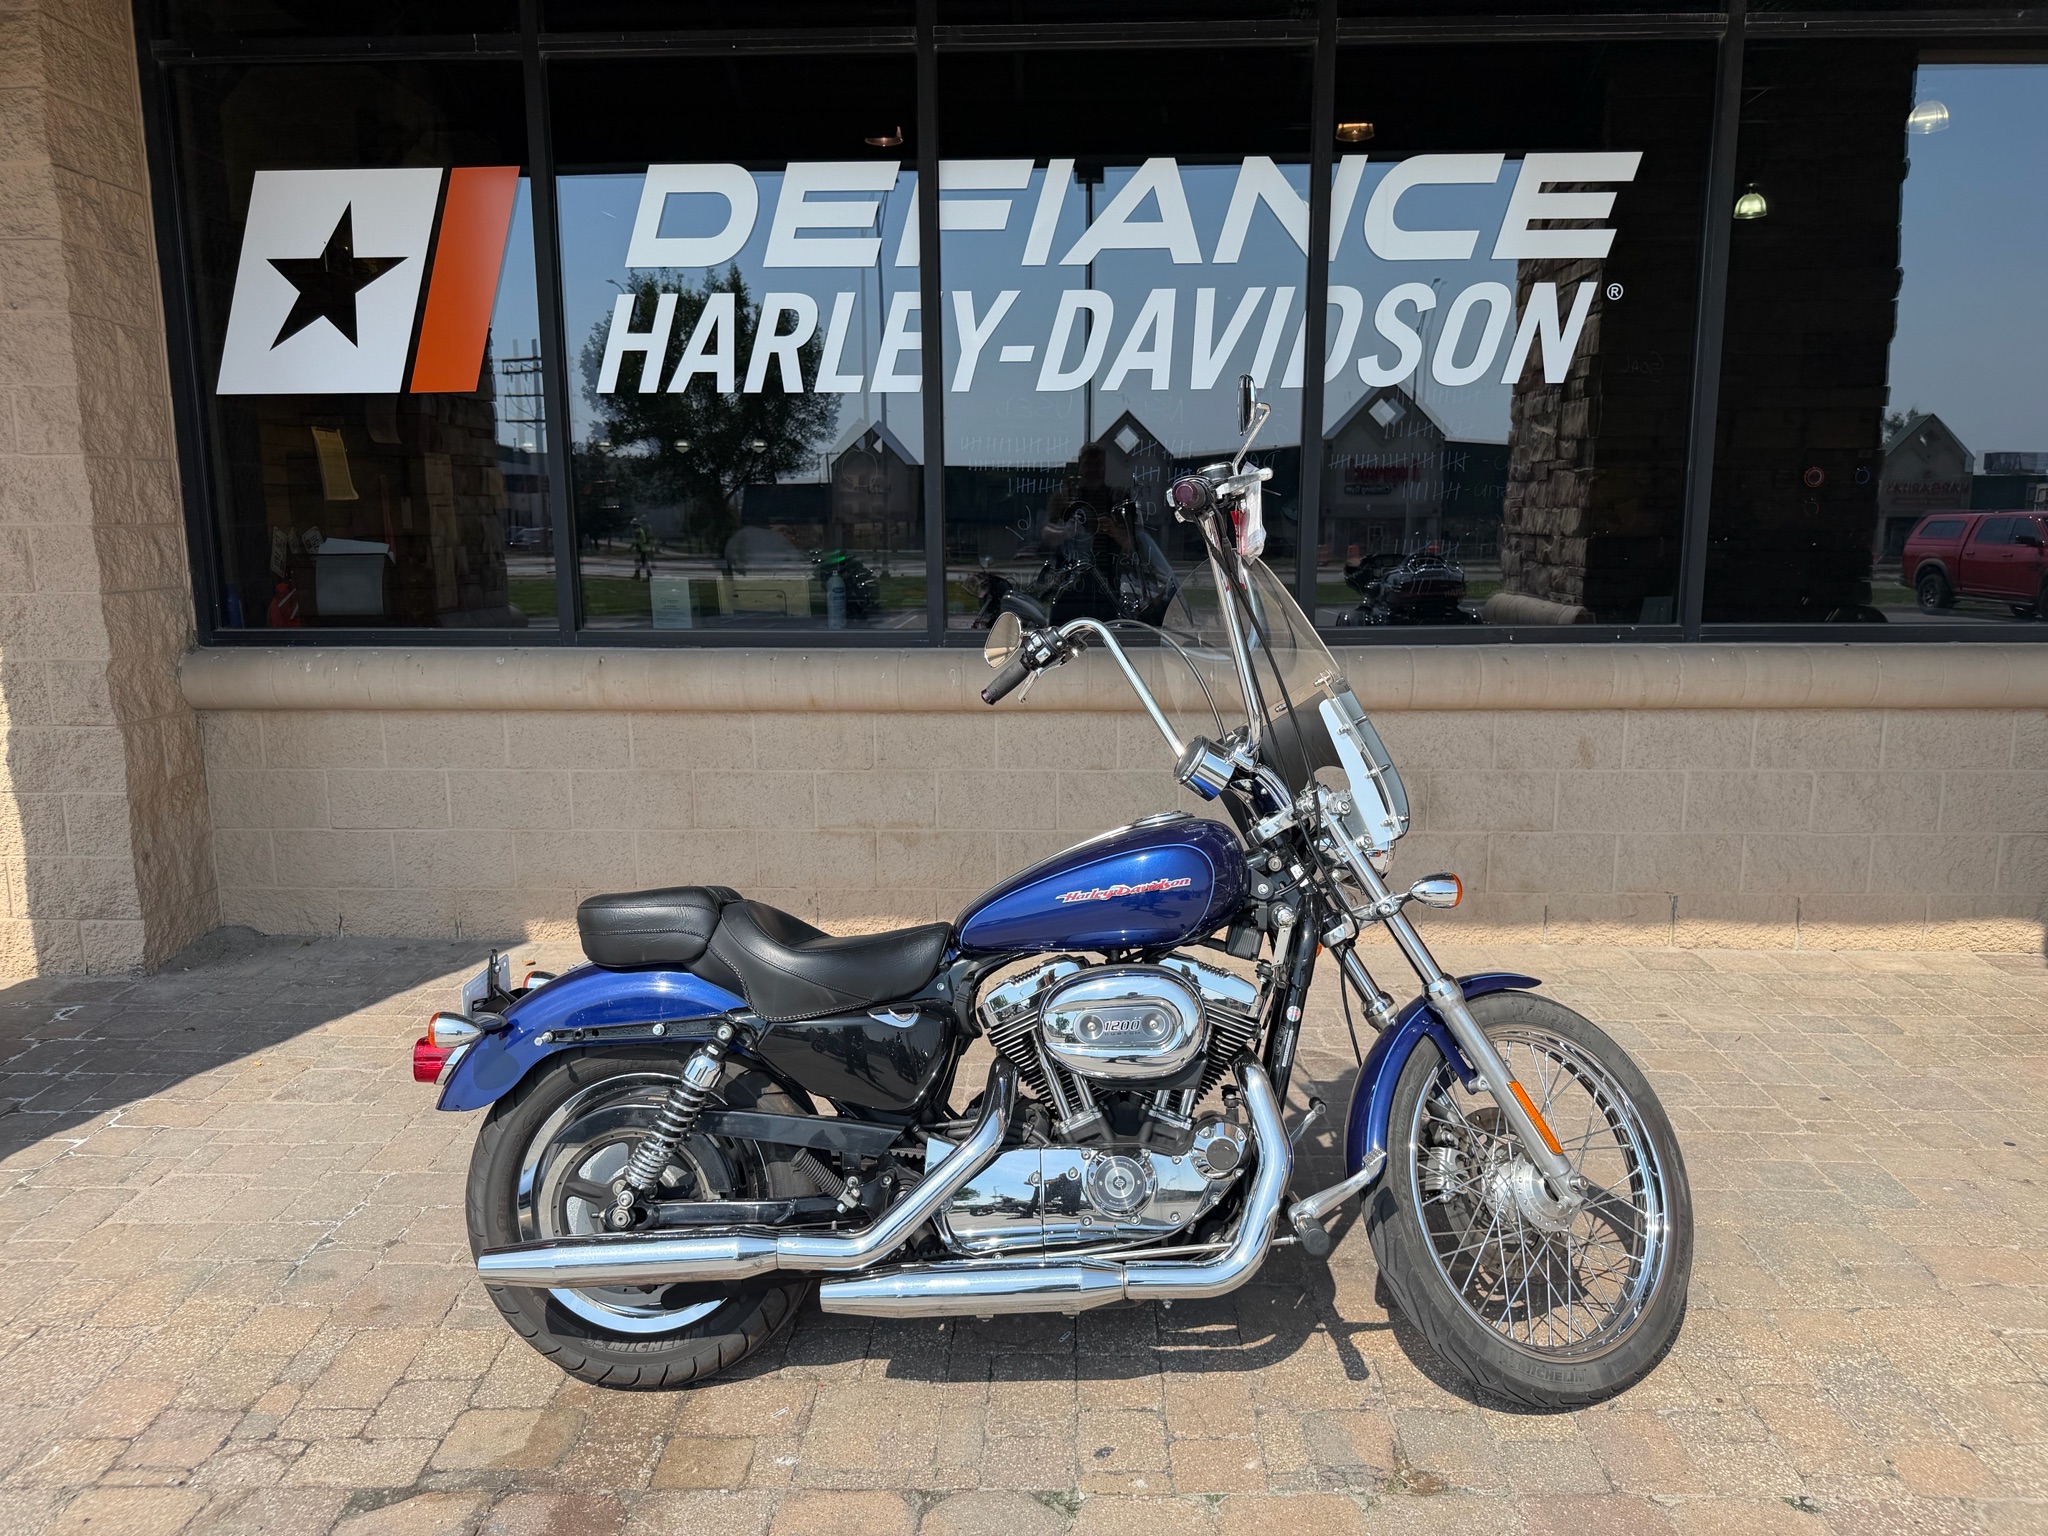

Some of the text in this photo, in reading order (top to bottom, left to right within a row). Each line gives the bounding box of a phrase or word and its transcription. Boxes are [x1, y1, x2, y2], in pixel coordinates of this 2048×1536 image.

[624, 151, 1643, 268] DEFIANCE
[596, 282, 1598, 393] HARLEY-DAVIDSON
[1103, 1019, 1142, 1032] 1200
[607, 1324, 705, 1352] MICHELIN
